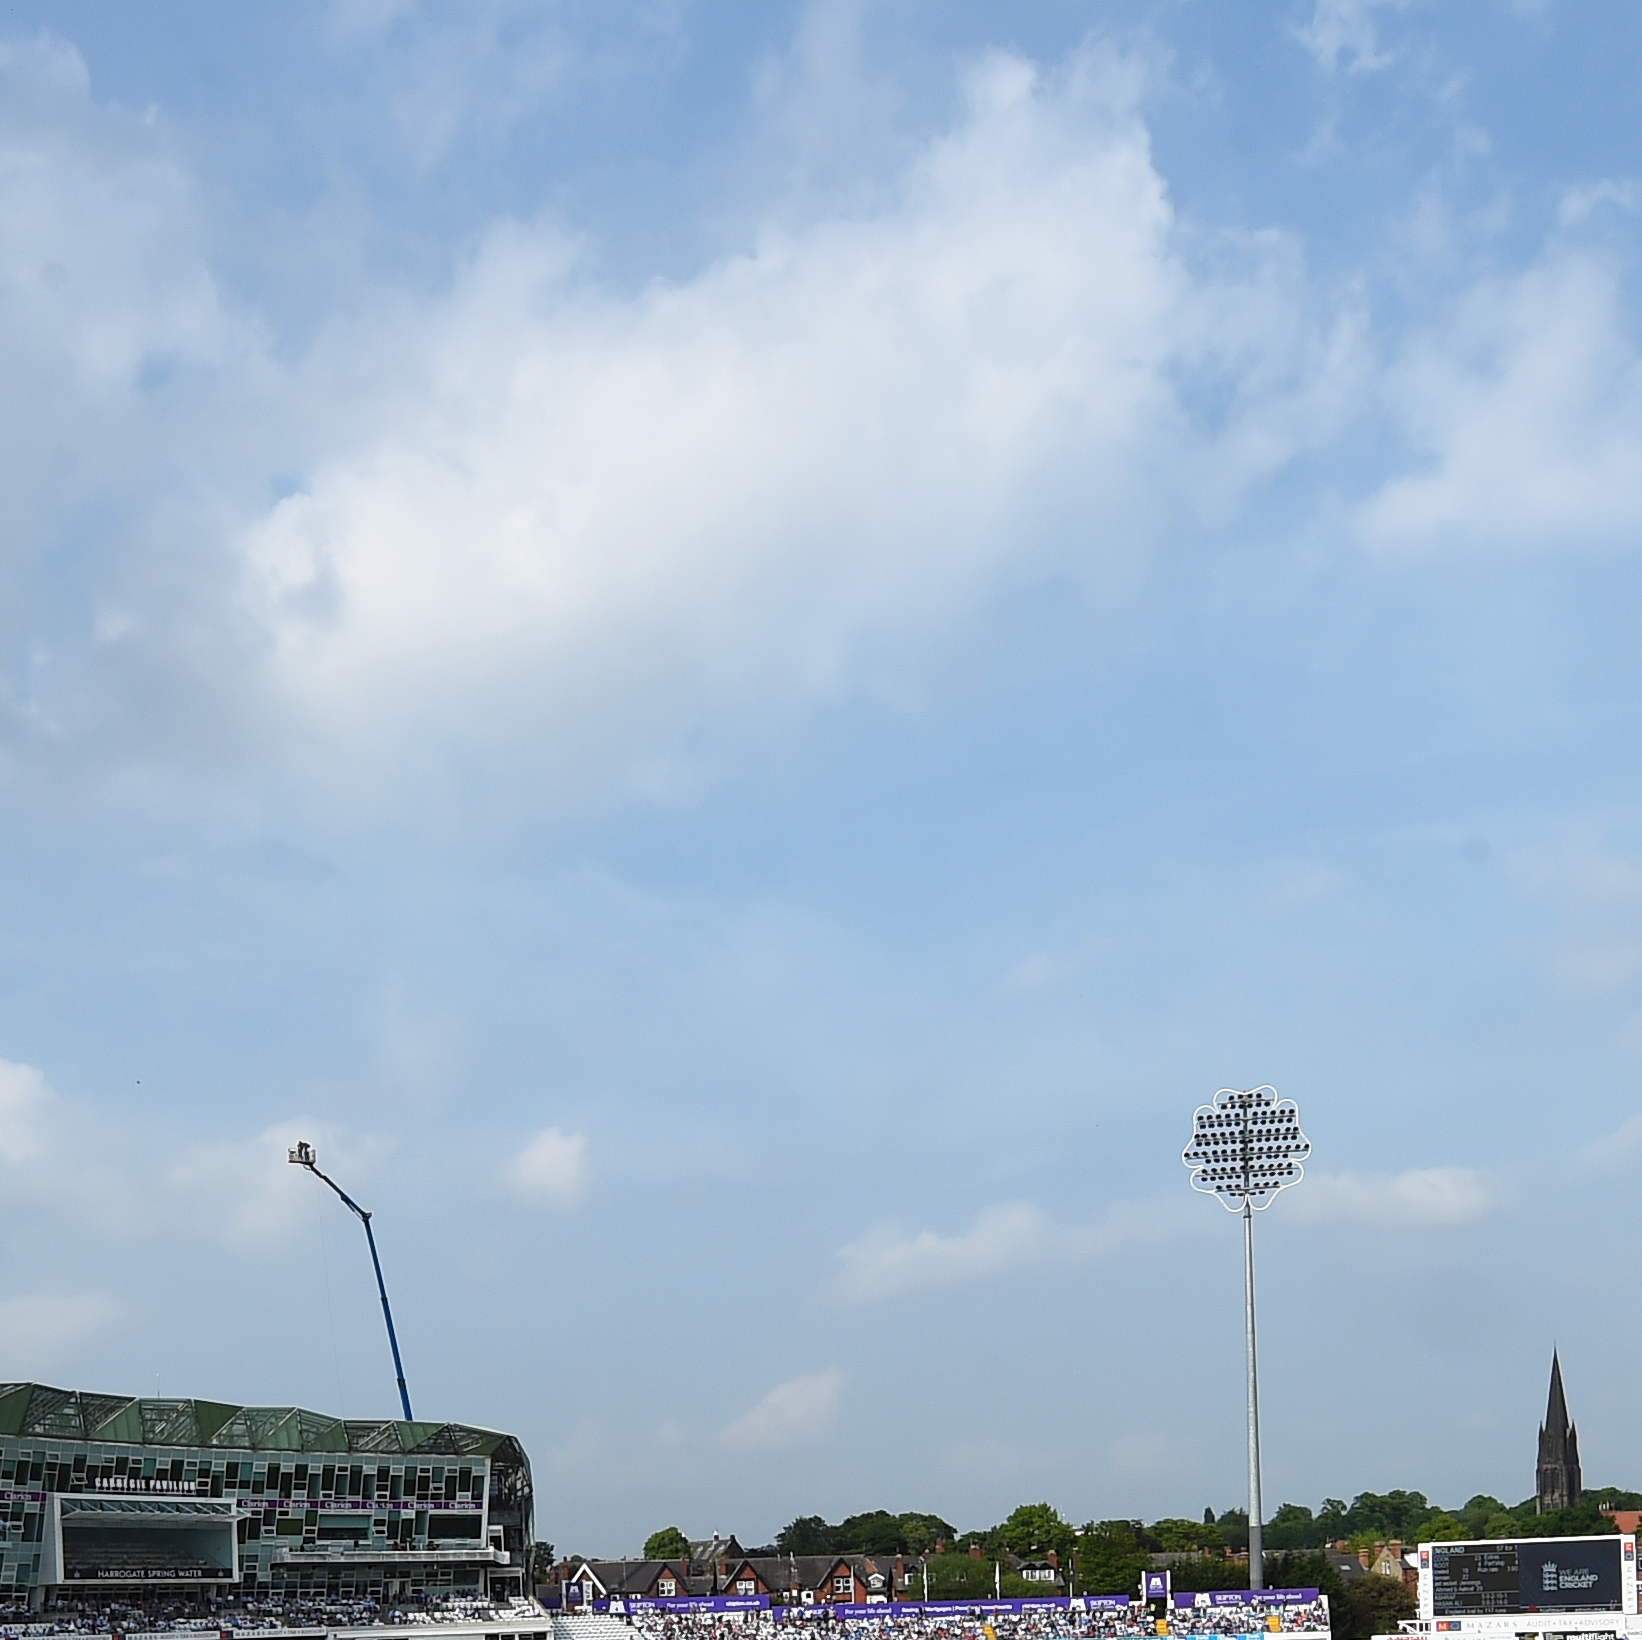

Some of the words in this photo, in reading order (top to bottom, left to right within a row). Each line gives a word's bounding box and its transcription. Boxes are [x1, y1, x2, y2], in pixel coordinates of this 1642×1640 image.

[150, 1479, 196, 1491] PAVILION
[148, 1569, 176, 1578] SPRING
[1559, 1574, 1599, 1582] ENGLAND
[1559, 1581, 1593, 1589] CRICKET
